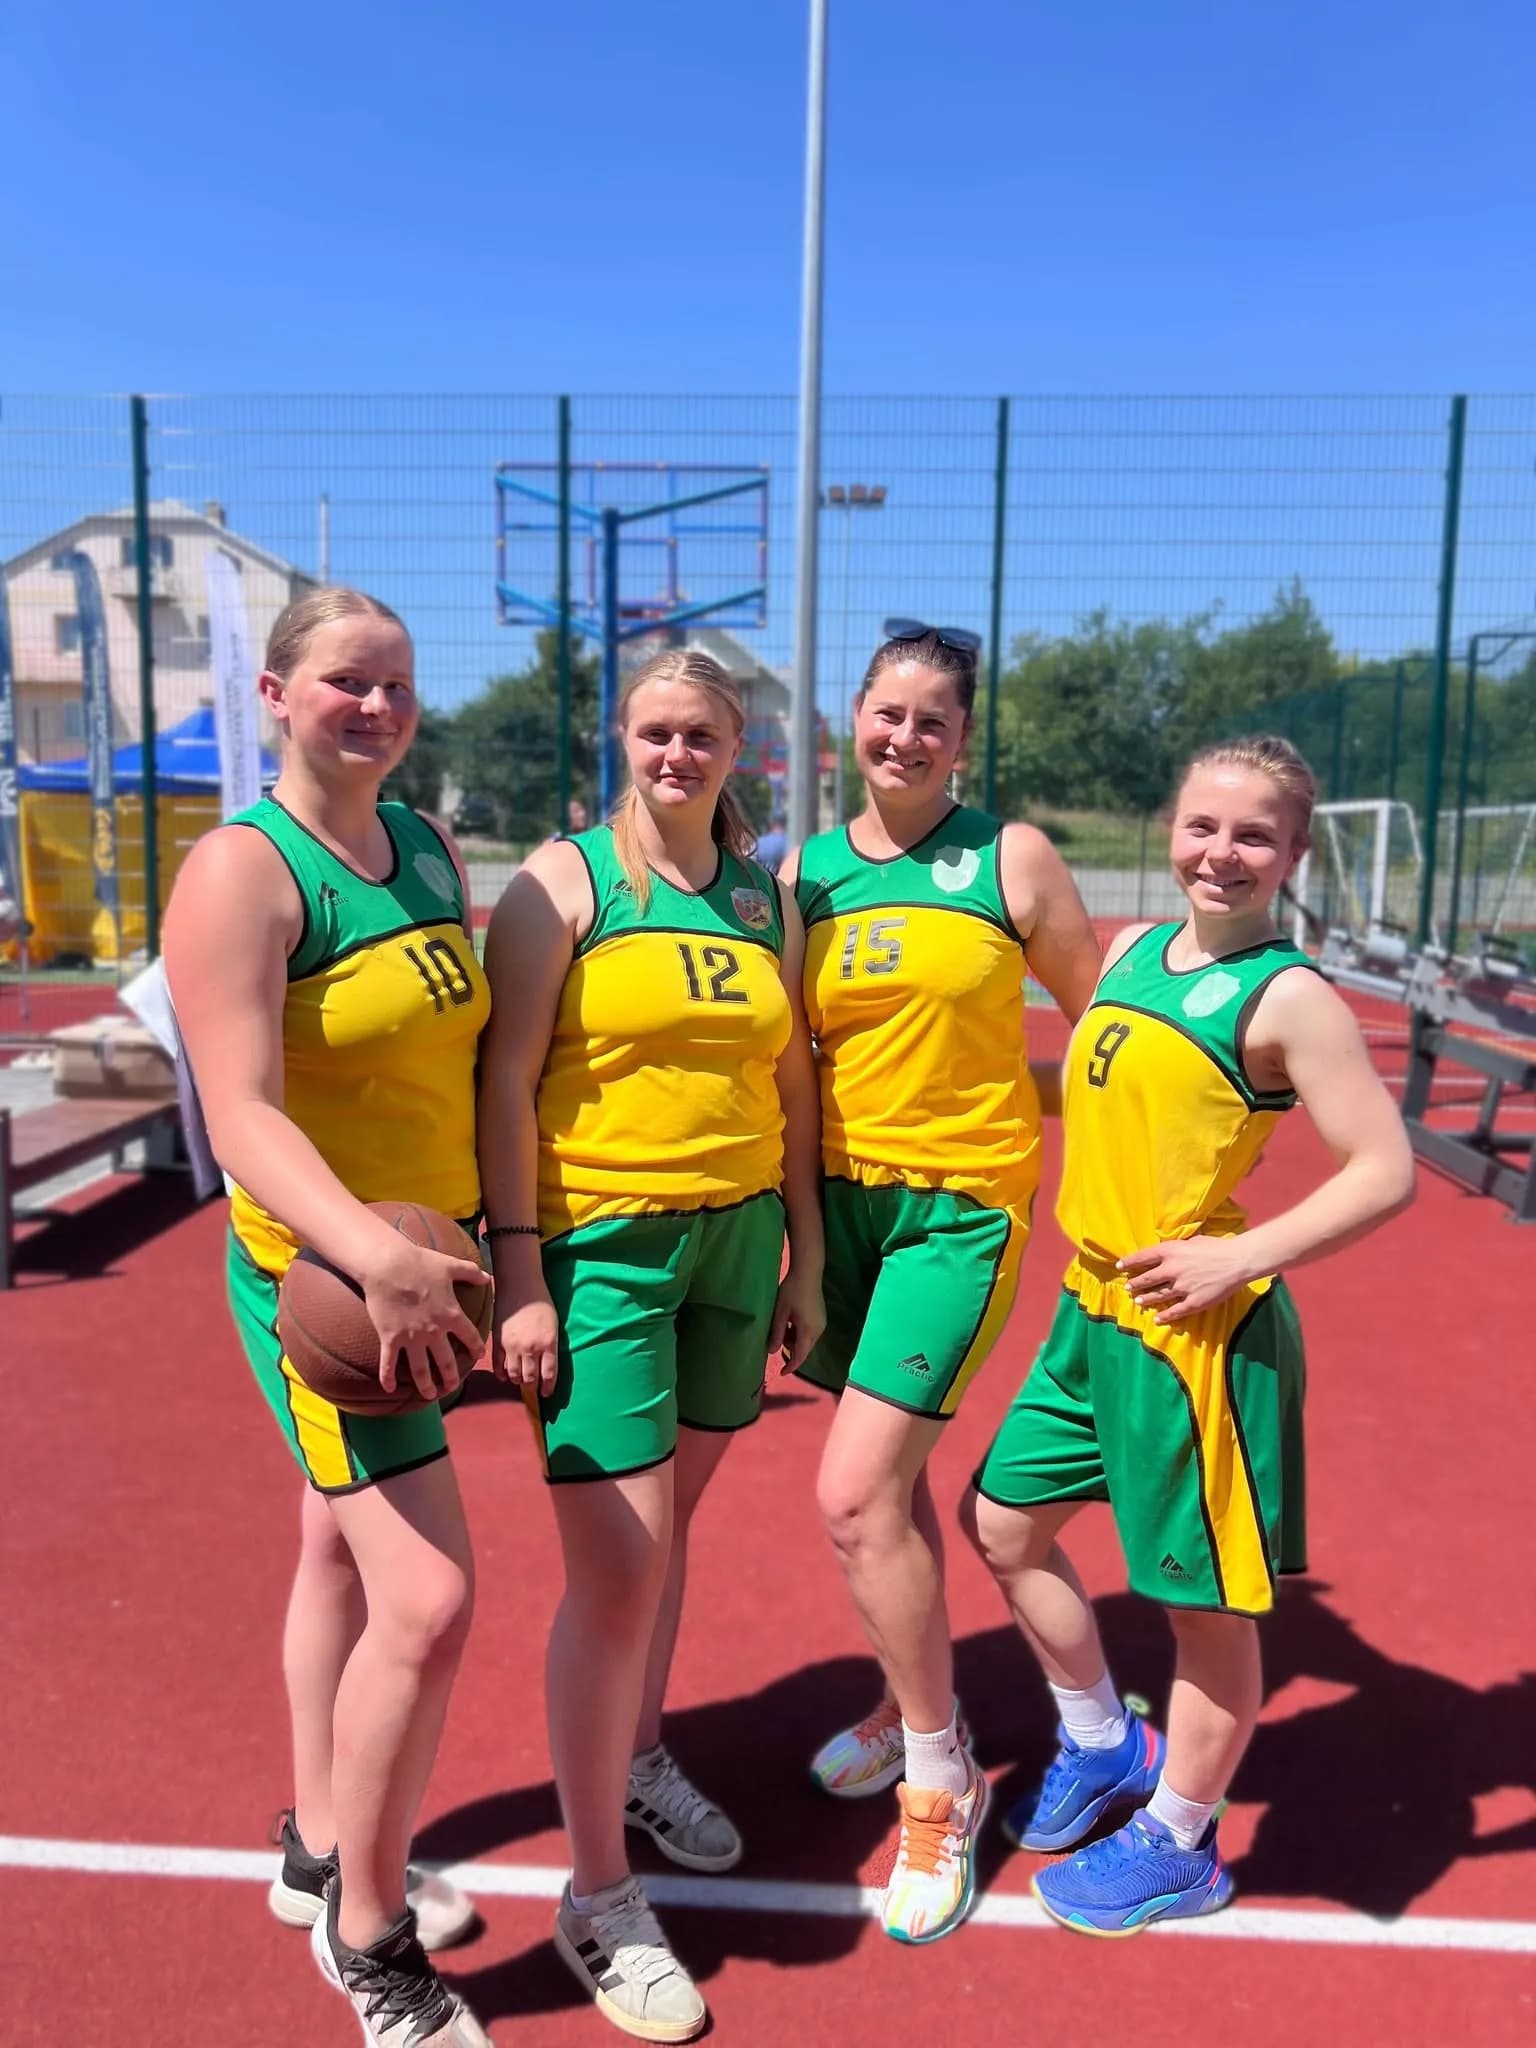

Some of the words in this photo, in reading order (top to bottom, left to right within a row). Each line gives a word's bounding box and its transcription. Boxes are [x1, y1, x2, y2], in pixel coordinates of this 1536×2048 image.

[401, 937, 473, 1015] 10
[675, 942, 751, 1004] 12
[840, 918, 907, 979] 15
[1087, 1022, 1131, 1089] 9
